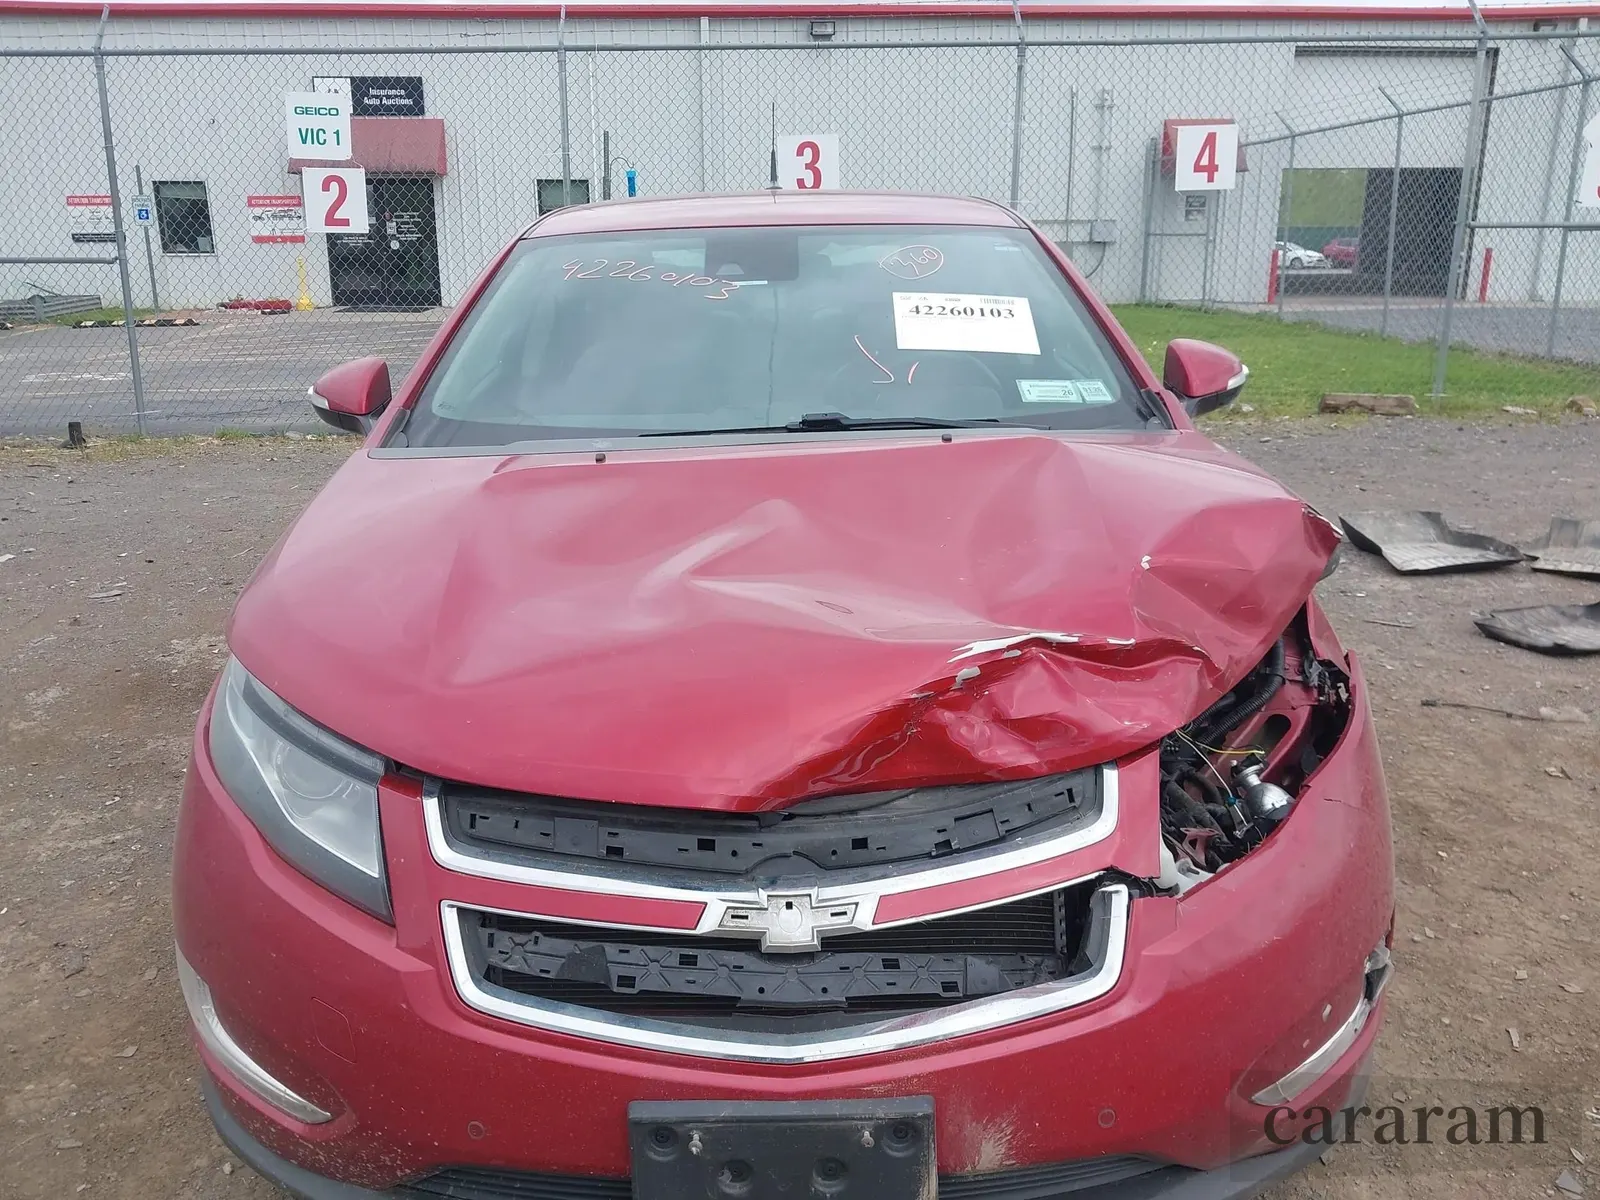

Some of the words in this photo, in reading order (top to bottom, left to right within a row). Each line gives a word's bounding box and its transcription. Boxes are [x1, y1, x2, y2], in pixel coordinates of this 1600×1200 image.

[369, 87, 405, 96] Insurance
[364, 97, 380, 105] Auto
[382, 97, 413, 105] Auctions
[294, 106, 340, 117] GEICO
[298, 128, 327, 146] VIC
[333, 129, 341, 146] 1
[796, 141, 822, 189] 3
[1193, 132, 1219, 183] 4
[321, 174, 351, 227] 2
[908, 304, 1015, 319] 42260103
